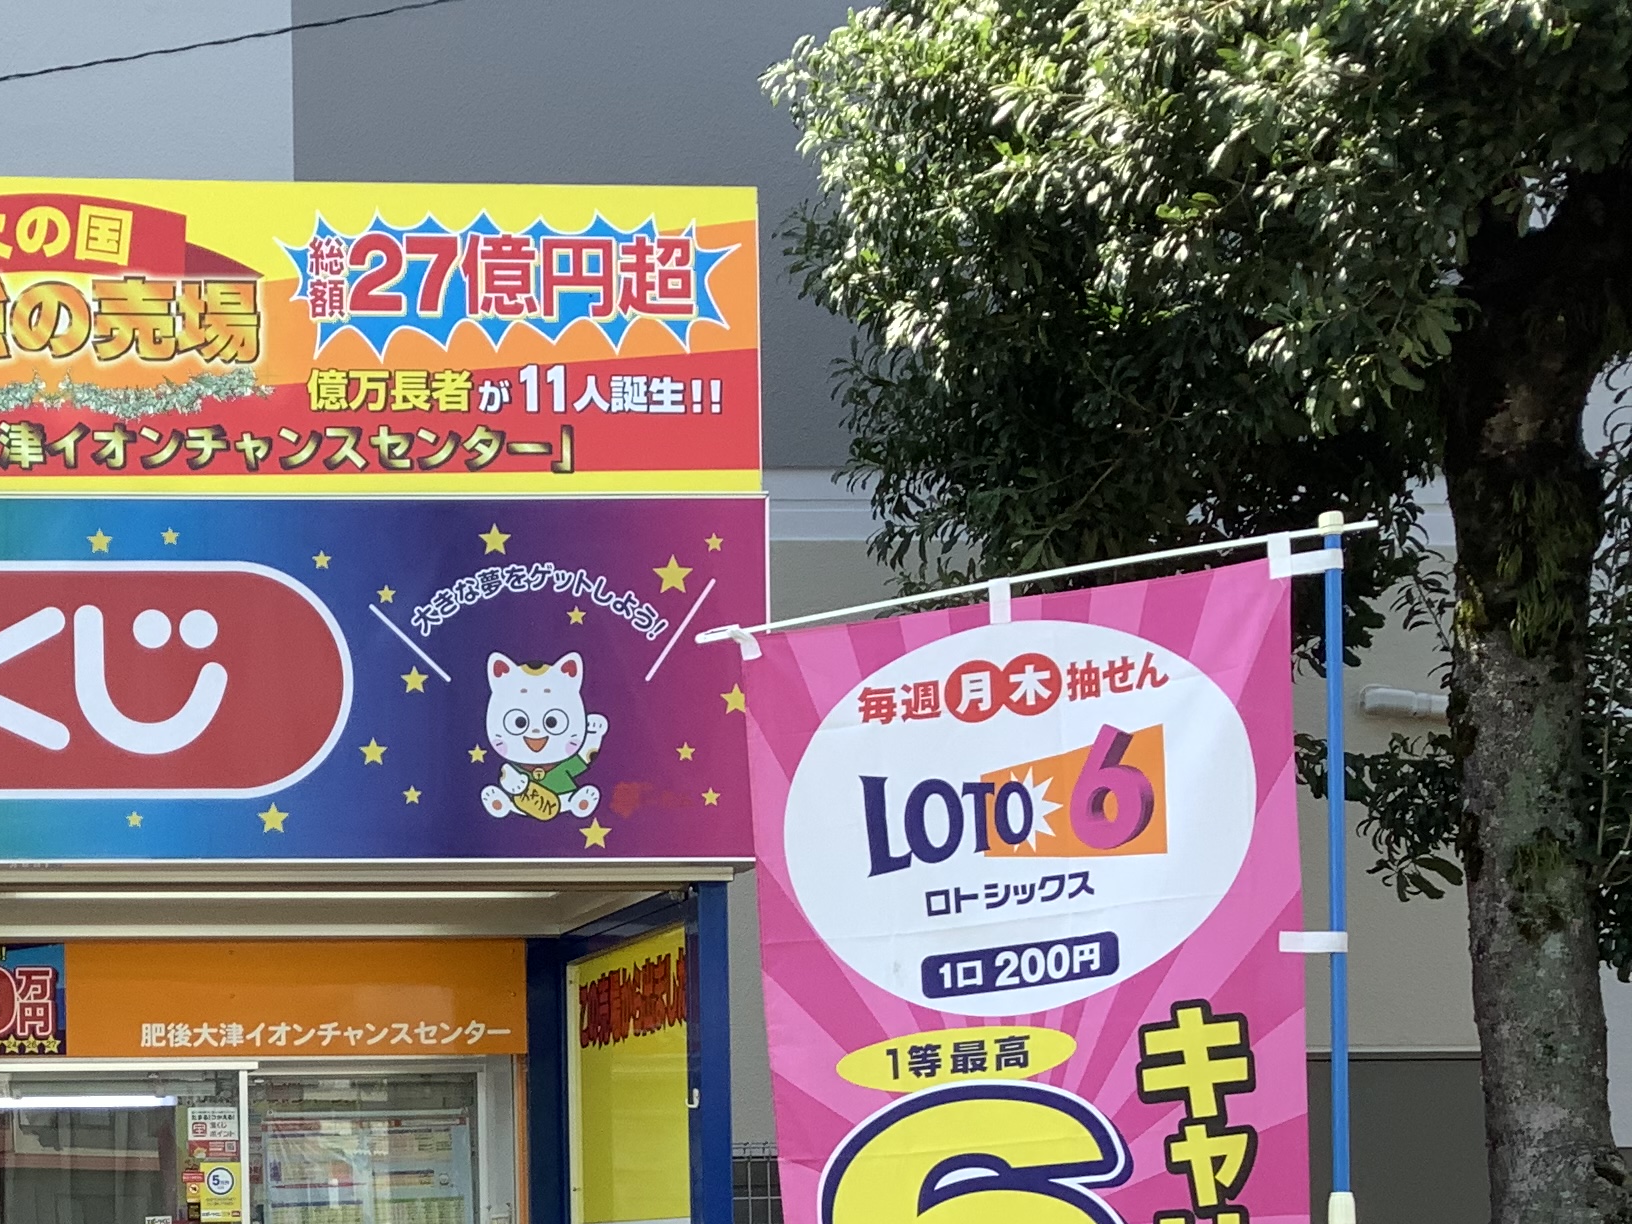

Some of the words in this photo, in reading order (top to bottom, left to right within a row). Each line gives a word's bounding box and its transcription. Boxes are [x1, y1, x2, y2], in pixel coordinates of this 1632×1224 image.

[307, 236, 347, 320] 総額
[346, 233, 700, 321] 27億円超
[411, 562, 669, 641] 大きな夢をゲットしよう!
[859, 773, 1034, 878] LOTO
[1069, 723, 1155, 850] 6
[925, 871, 1095, 917] ロトシックス
[993, 940, 1101, 988] 200円
[140, 1021, 511, 1049] 肥後大津イオンチャンスセンター
[884, 1034, 1031, 1080] 1等最高
